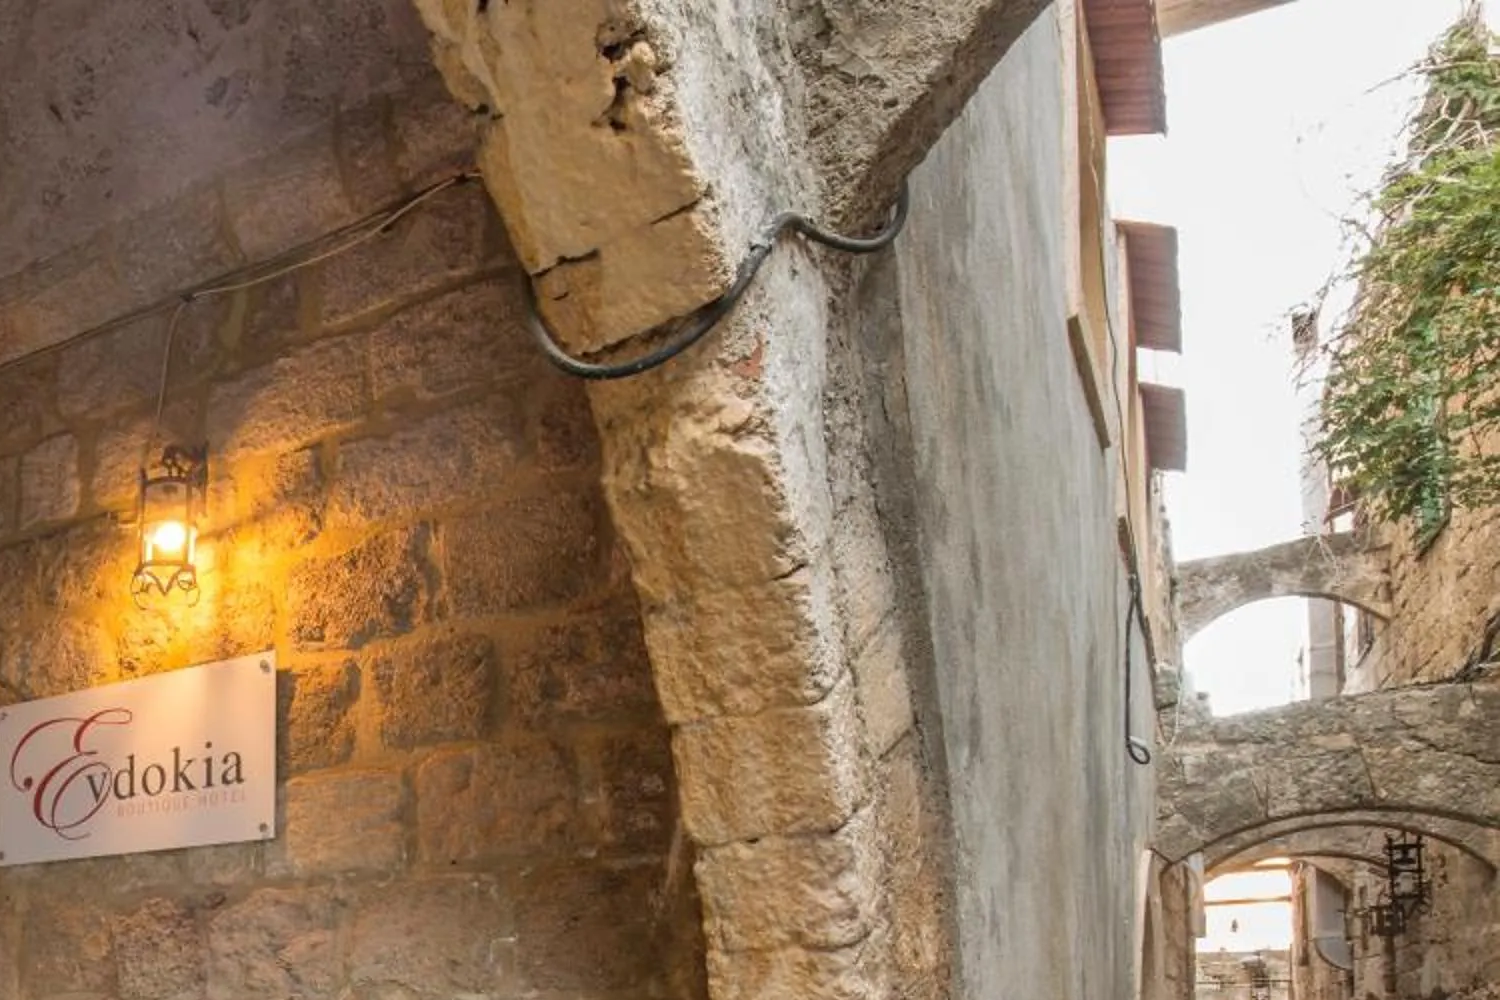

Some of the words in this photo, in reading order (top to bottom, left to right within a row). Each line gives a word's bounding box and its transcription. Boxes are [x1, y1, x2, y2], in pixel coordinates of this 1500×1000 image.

[10, 707, 246, 840] Evdokia
[116, 796, 191, 818] BOUTIQUE
[197, 789, 247, 810] HOTEL
